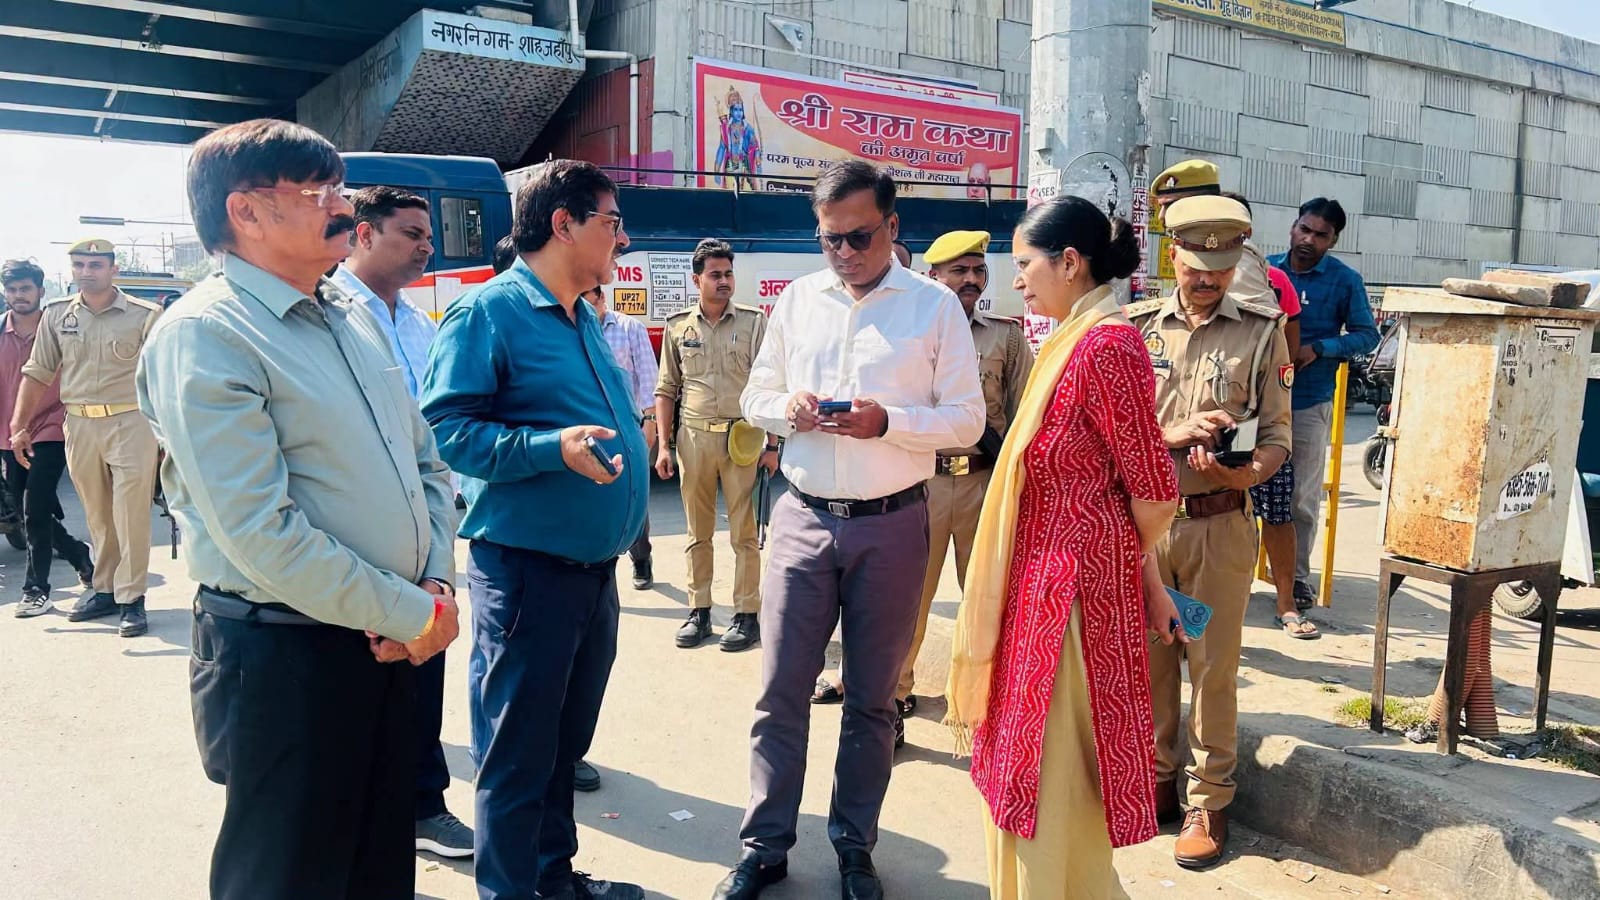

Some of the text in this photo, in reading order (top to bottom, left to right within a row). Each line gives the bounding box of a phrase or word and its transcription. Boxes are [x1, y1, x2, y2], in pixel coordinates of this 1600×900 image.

[777, 92, 1012, 152] श्री राम कथा
[766, 153, 790, 165] परम
[792, 157, 815, 169] पूज्य
[860, 140, 966, 166] की अमृत वर्षा
[617, 266, 643, 282] MS
[621, 292, 640, 301] UP27
[616, 302, 645, 311] DT 7174
[979, 299, 991, 311] Oil
